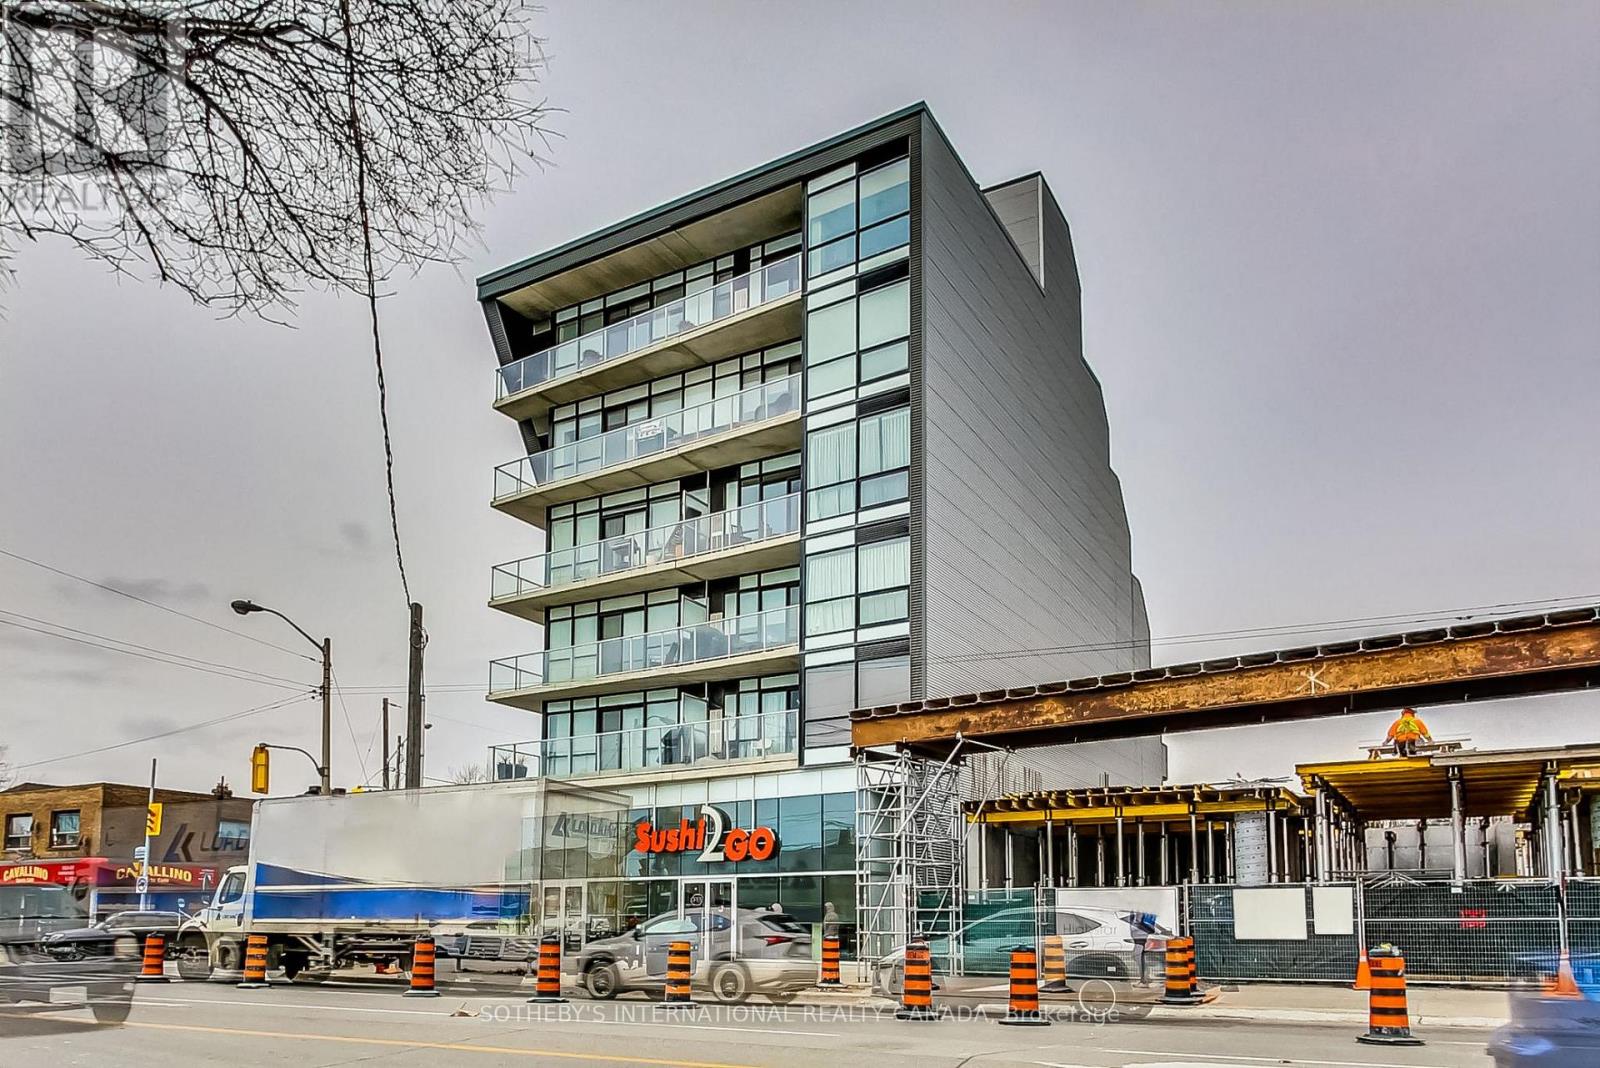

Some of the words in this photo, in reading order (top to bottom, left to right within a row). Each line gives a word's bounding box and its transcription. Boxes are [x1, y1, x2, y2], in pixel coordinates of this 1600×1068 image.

[635, 818, 706, 853] Sushi
[697, 805, 724, 861] 2
[725, 827, 775, 861] GO
[4, 866, 48, 881] CAVALLINO
